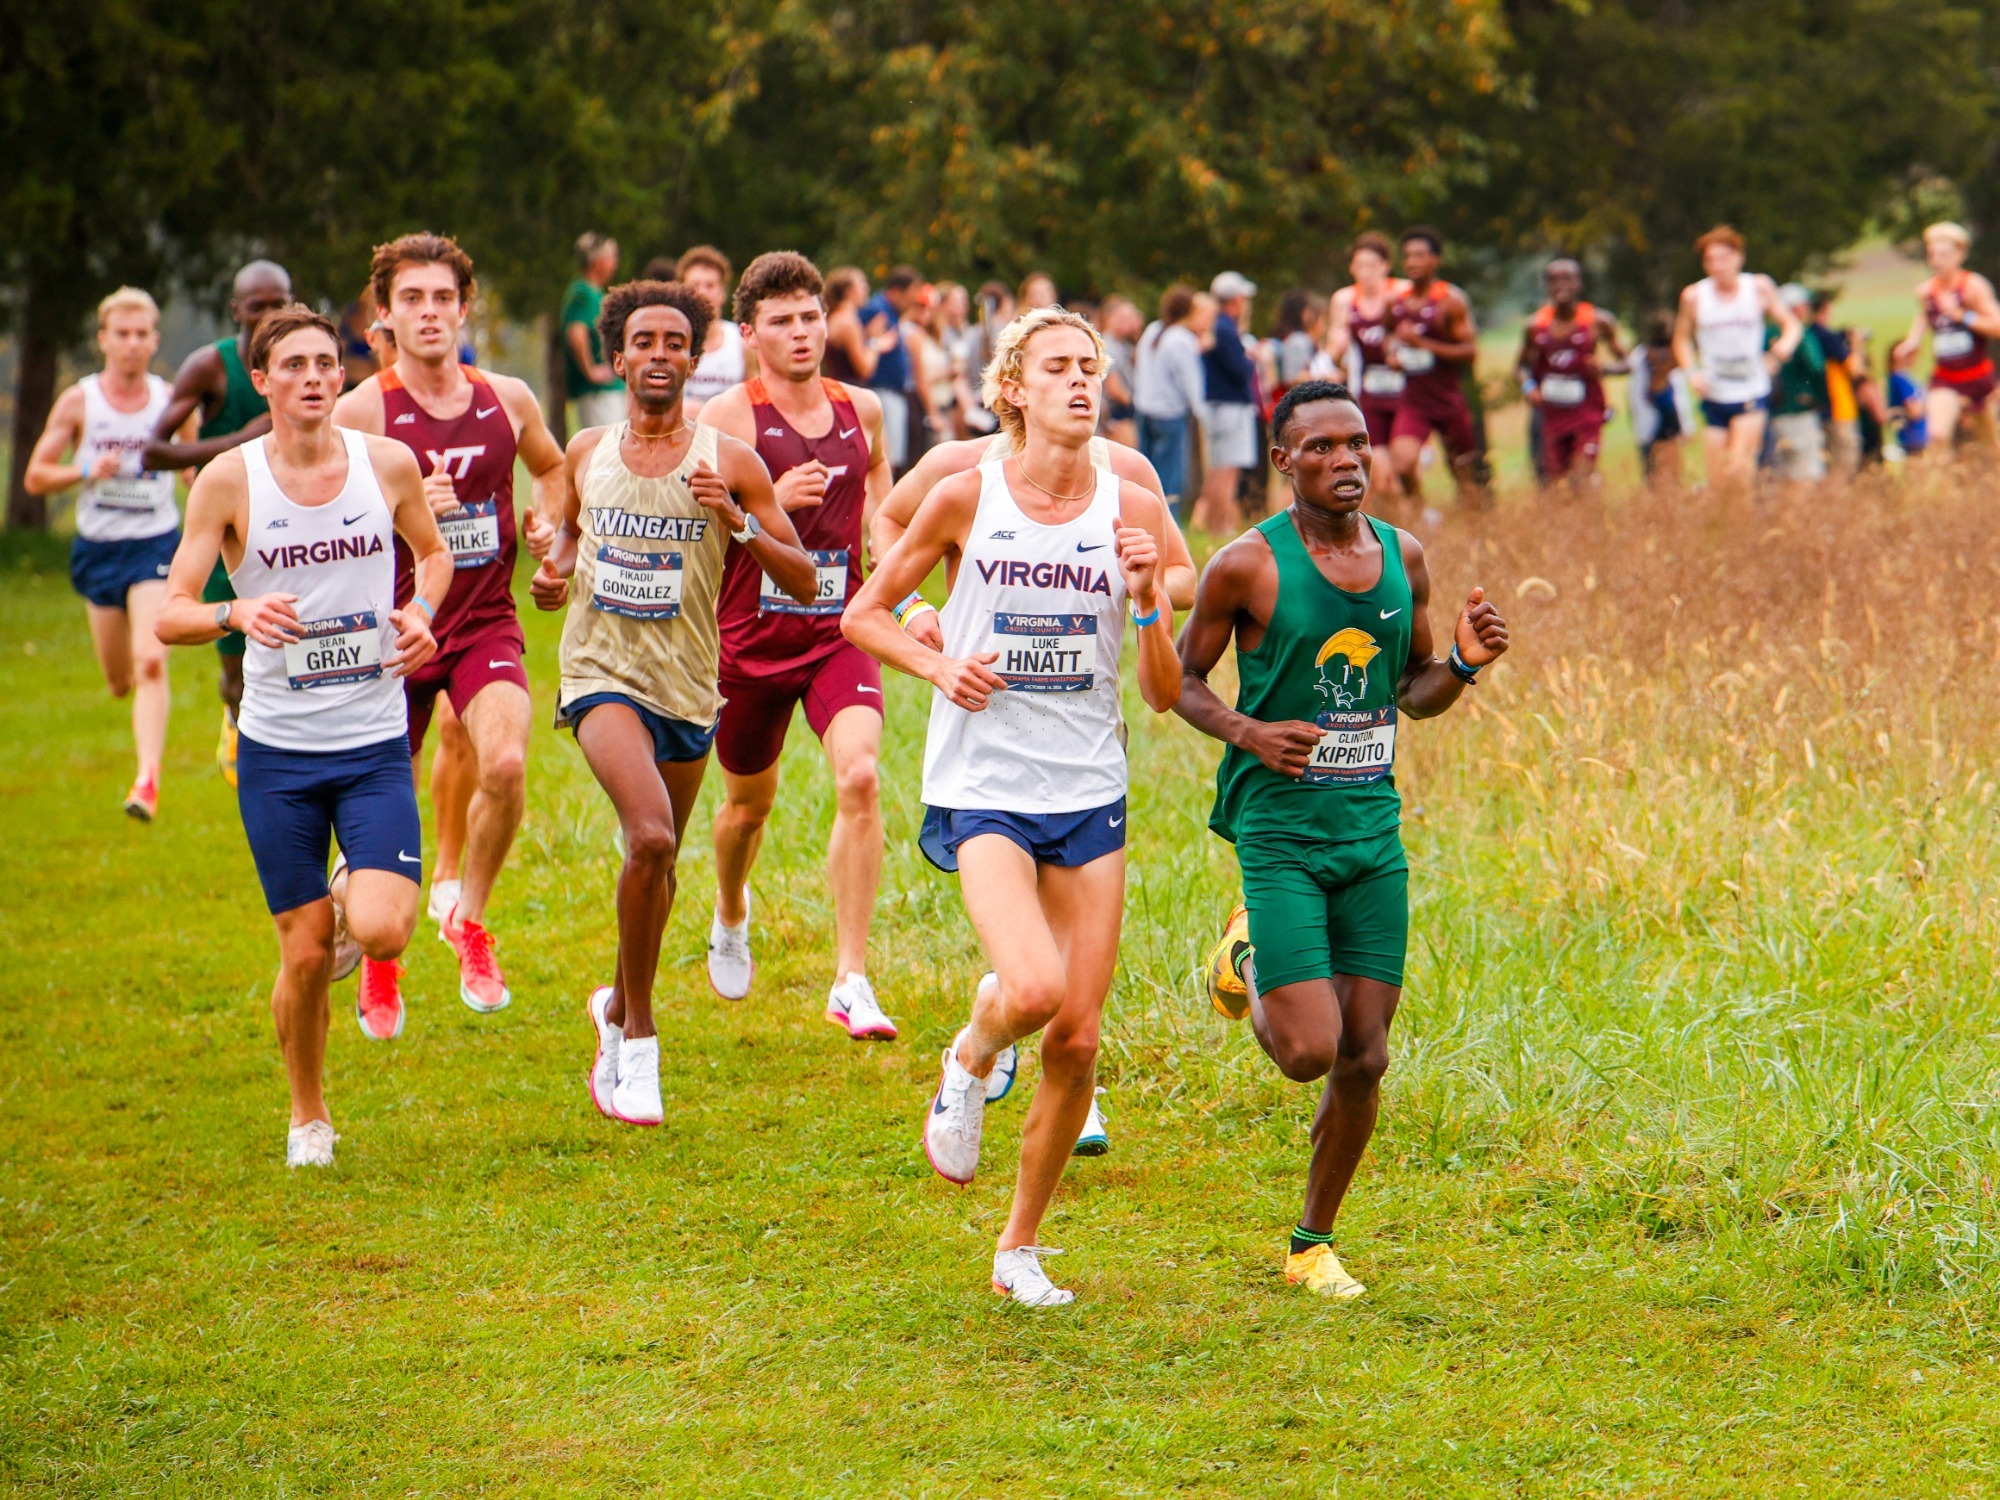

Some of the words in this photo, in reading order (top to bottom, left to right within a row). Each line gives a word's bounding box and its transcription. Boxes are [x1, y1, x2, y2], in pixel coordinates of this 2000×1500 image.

[266, 519, 289, 529] ACC
[445, 530, 490, 551] HLKE
[988, 530, 1017, 540] ACC
[258, 533, 383, 570] VIRGINIA
[607, 546, 650, 564] VIRGINIA
[620, 569, 654, 582] FIKADU
[976, 559, 1111, 597] VIRGINIA
[603, 579, 672, 599] GONZALEZ
[1006, 615, 1060, 627] VIRGINIA
[319, 636, 346, 649] SEAN
[1032, 638, 1060, 649] LUKE
[306, 645, 361, 671] GRAY
[1006, 650, 1082, 673] HNATT
[1329, 712, 1373, 724] VIRGINIA
[1338, 730, 1374, 743] CLINTON
[1316, 743, 1384, 764] KIPRUTO
